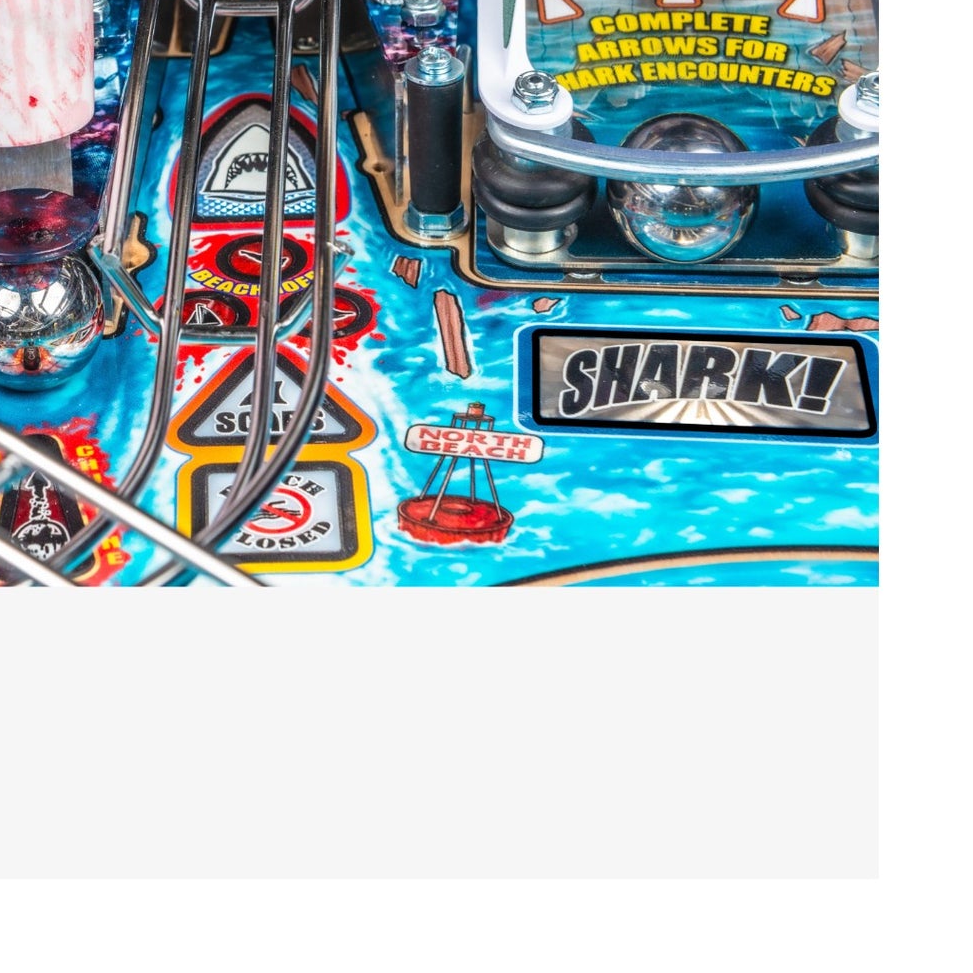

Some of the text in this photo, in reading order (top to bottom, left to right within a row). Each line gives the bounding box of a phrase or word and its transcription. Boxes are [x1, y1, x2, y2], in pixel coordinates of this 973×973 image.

[589, 11, 770, 35] COMPLETE
[577, 36, 789, 63] ARROWS FOR
[555, 61, 839, 97] HARK ENCOUNTERS
[189, 268, 317, 297] BEACHOE
[558, 342, 848, 418] SHARK!
[418, 427, 532, 449] NORTH
[419, 439, 527, 461] BEACH
[235, 520, 332, 551] LOSED
